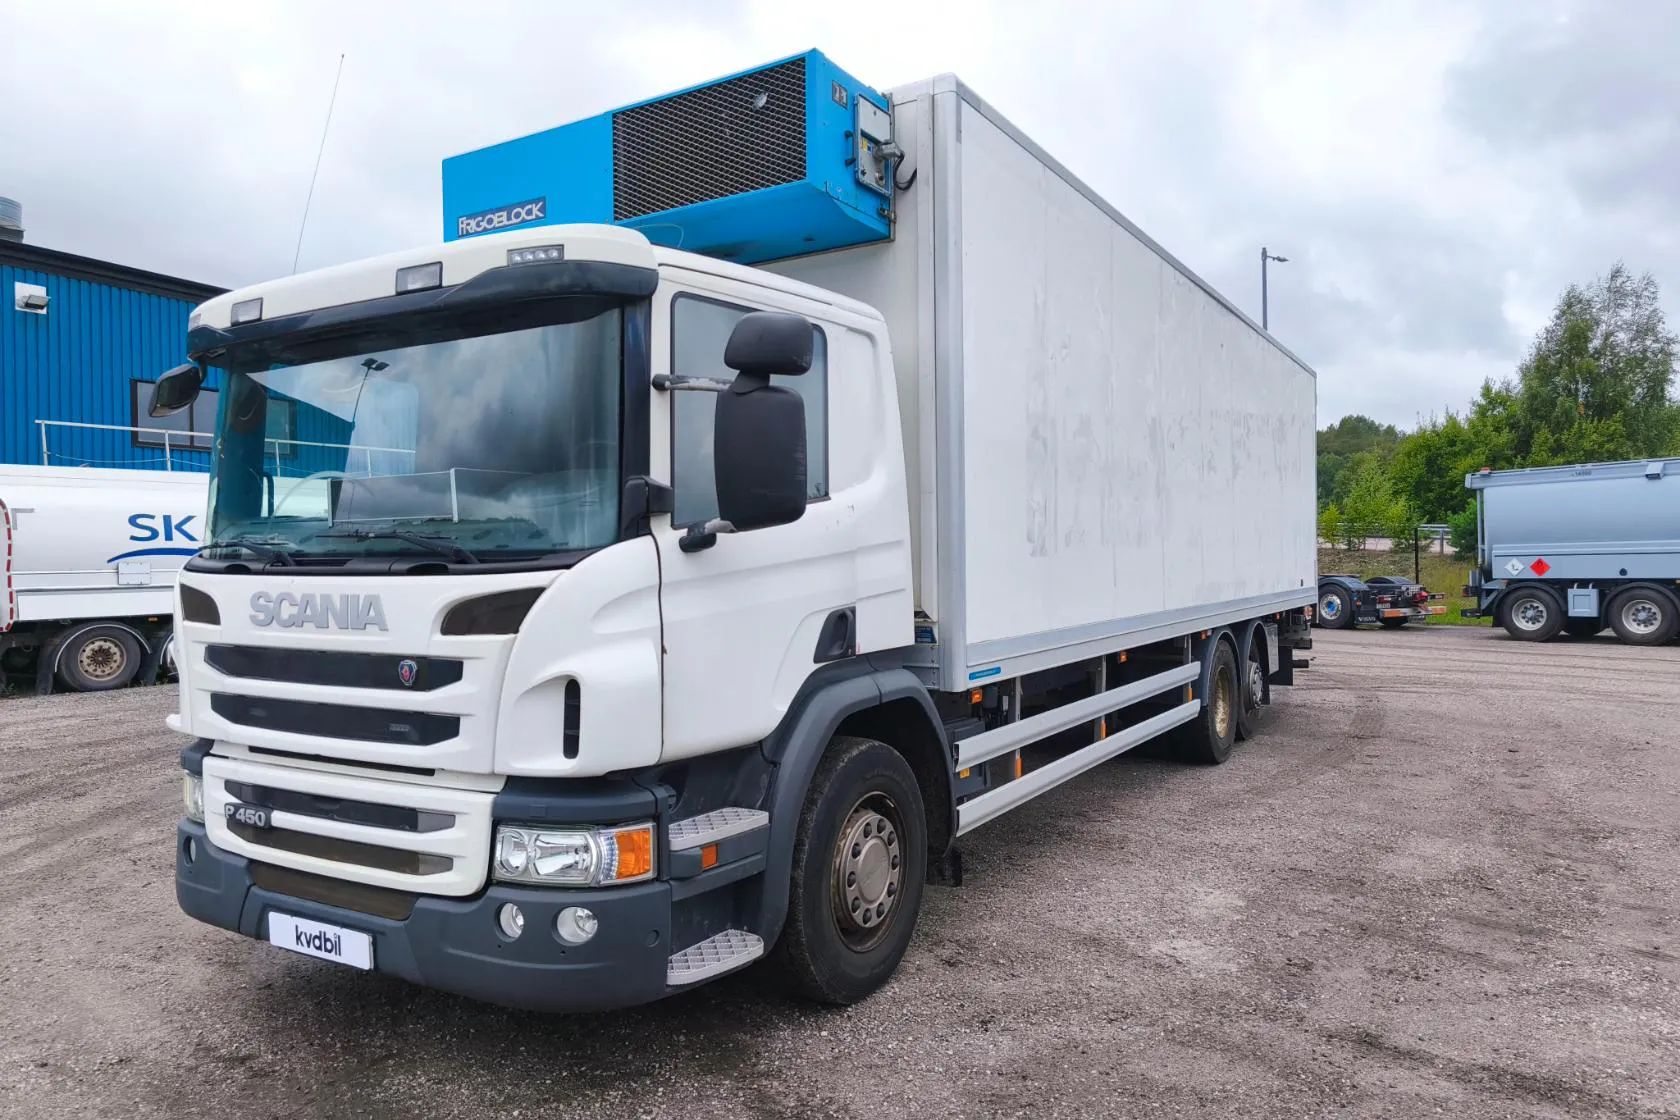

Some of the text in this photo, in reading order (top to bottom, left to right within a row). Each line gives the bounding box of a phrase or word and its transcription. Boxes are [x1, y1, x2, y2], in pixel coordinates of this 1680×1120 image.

[127, 513, 199, 542] SK
[249, 590, 389, 632] SCANIA
[225, 804, 266, 827] P 450
[295, 924, 342, 957] kvdbil
